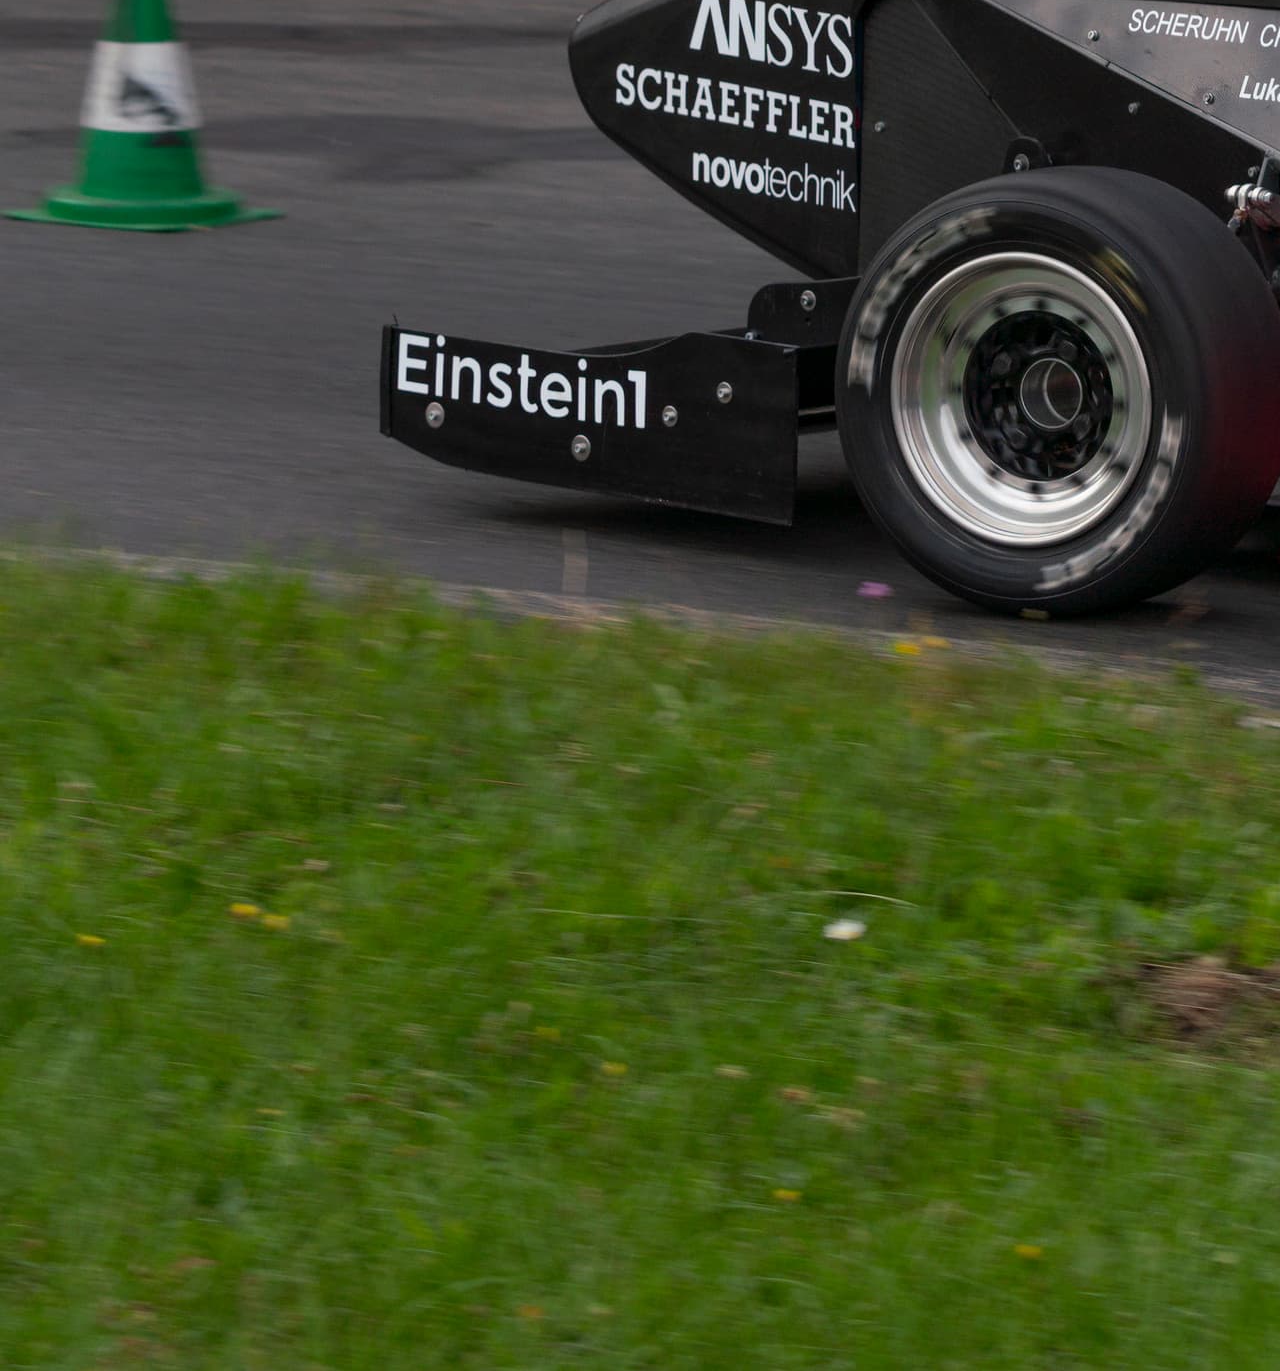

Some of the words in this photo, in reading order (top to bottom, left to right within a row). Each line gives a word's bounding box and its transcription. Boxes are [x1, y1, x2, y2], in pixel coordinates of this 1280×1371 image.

[1129, 9, 1249, 43] SCHERUHN
[616, 64, 855, 148] SCHAEFFLER
[693, 153, 855, 212] novotechnik
[398, 333, 646, 428] Einstein1
